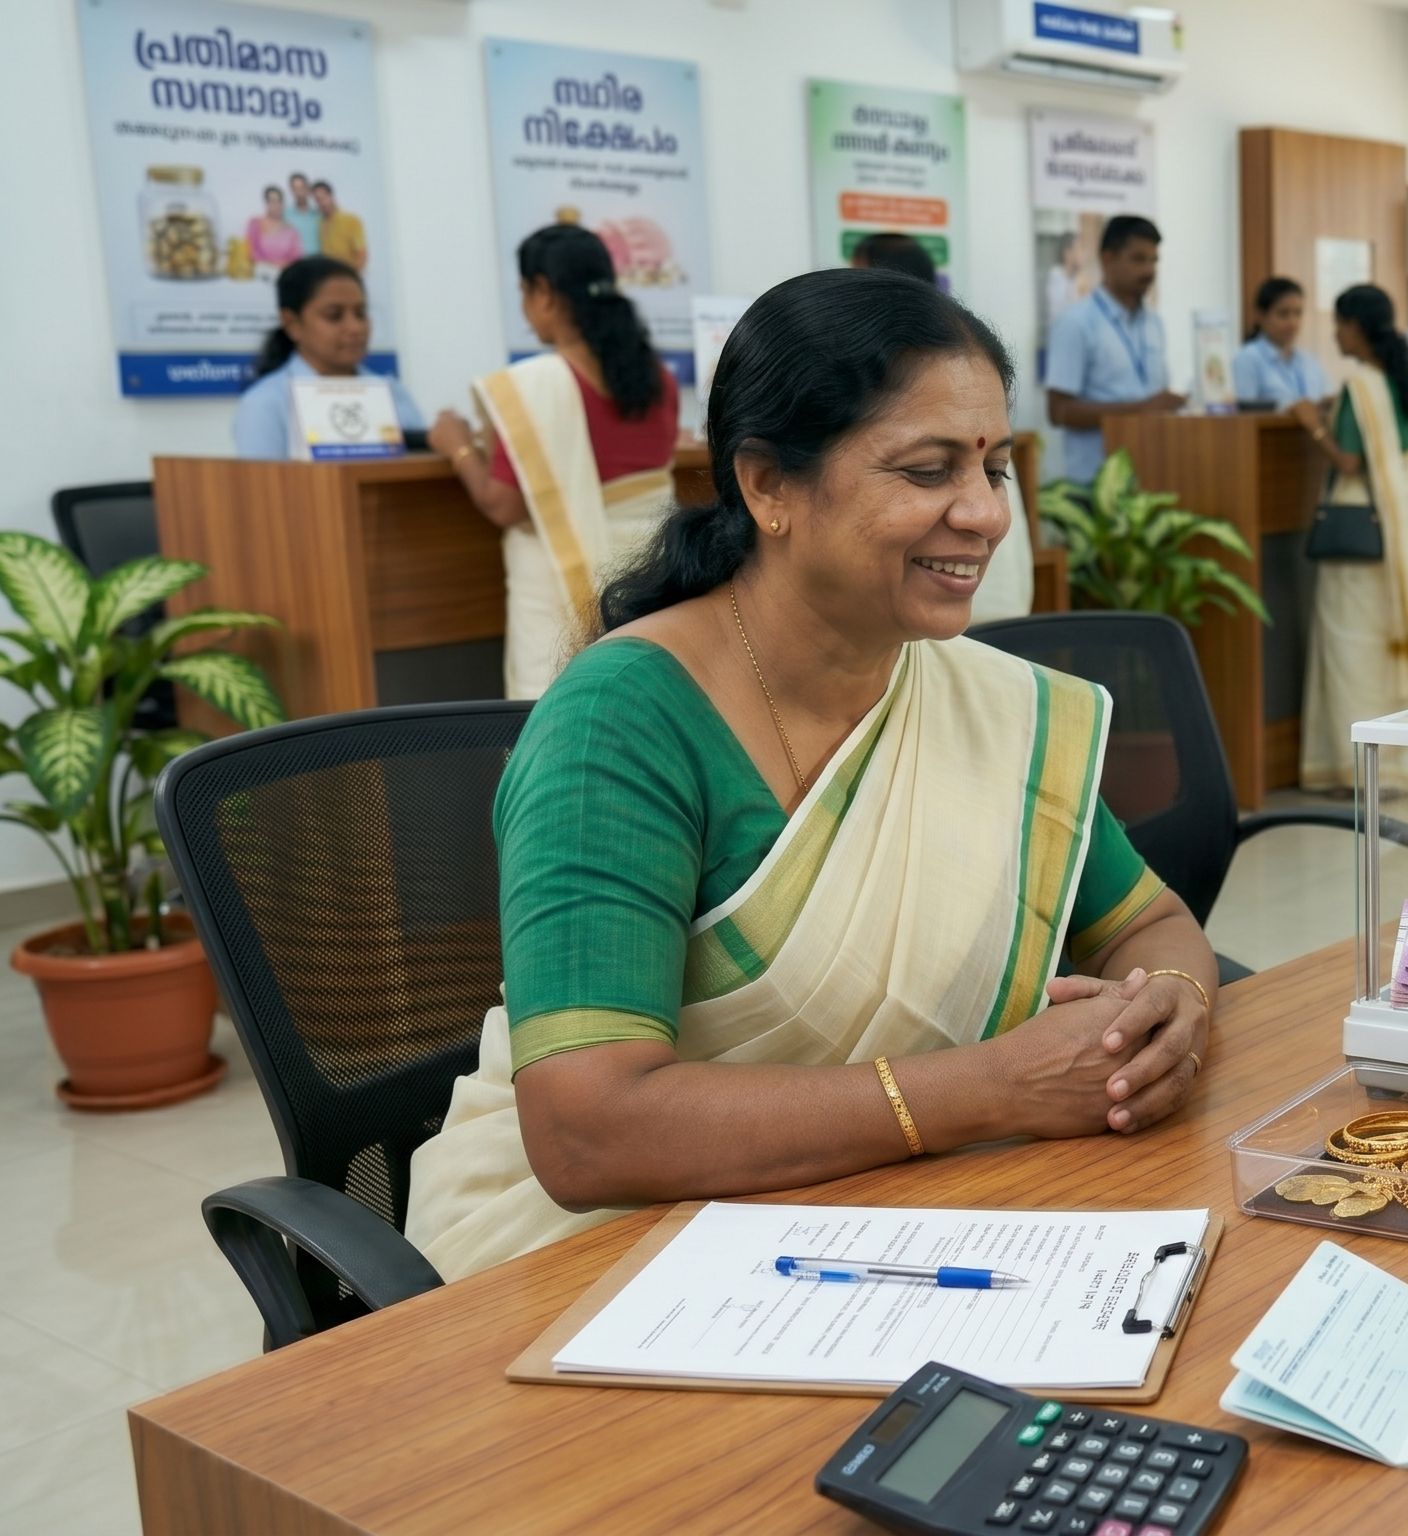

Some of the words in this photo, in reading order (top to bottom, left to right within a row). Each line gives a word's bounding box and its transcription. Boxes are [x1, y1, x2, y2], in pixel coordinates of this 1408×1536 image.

[135, 26, 328, 79] പ്രതിമാസ
[151, 76, 322, 128] സമ്പാദ്യം
[1085, 1439, 1103, 1449] 9
[1119, 1445, 1138, 1455] 6
[1154, 1452, 1173, 1462] 3
[1068, 1462, 1087, 1472] 8
[1104, 1468, 1123, 1478] 5
[1138, 1474, 1159, 1485] 2
[1049, 1484, 1069, 1496] 7
[1088, 1490, 1105, 1502] 4
[1123, 1499, 1143, 1508] 1
